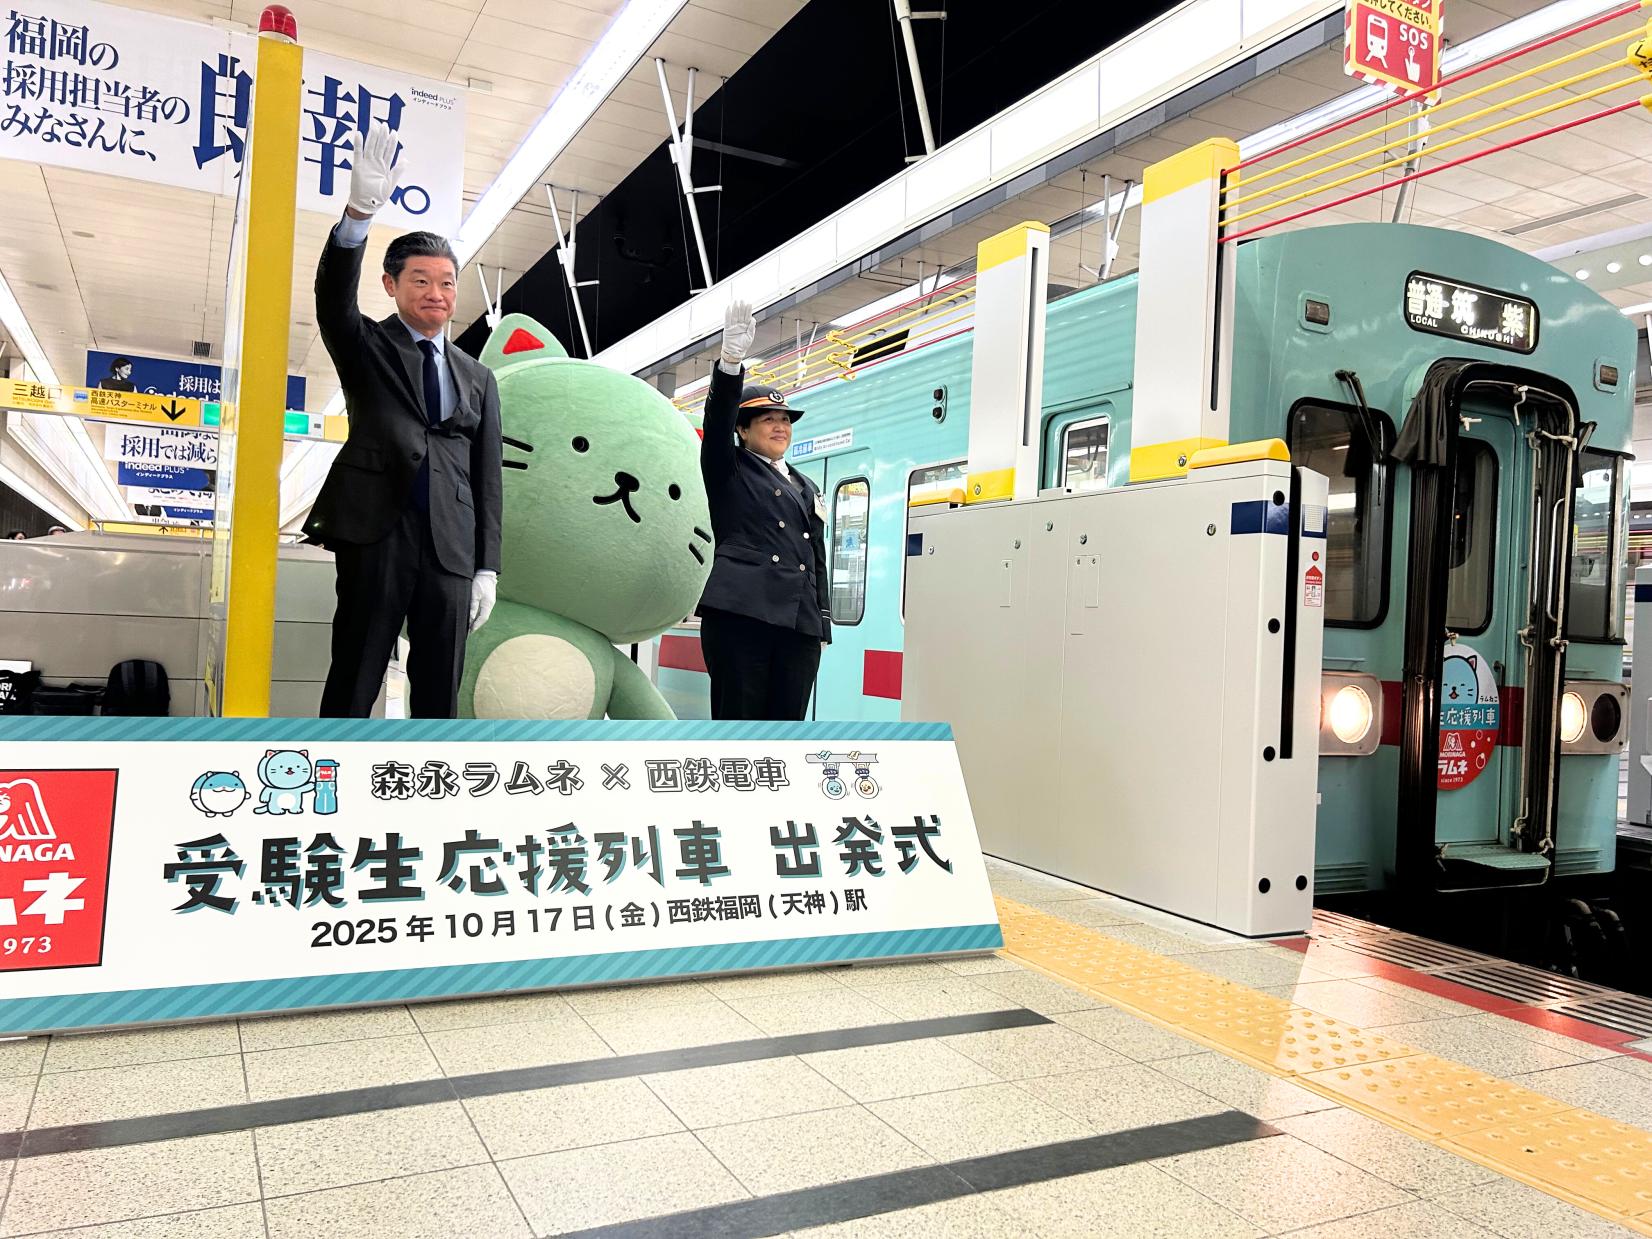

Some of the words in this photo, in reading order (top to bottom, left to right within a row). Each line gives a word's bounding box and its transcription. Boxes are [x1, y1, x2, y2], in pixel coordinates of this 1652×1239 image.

[5, 10, 119, 70] 福岡の
[1400, 24, 1428, 50] SOS
[3, 60, 191, 125] 採用担当者の
[411, 88, 438, 101] indeed
[0, 103, 157, 162] みなさんに、
[1407, 279, 1443, 319] 普通
[1410, 314, 1438, 328] LOCAL
[12, 383, 62, 399] 三越口
[178, 374, 221, 394] 採用は
[91, 390, 122, 399] 西鉄天神
[91, 397, 157, 411] 高速バスターミナル
[121, 434, 217, 464] 採用では減ら
[136, 472, 174, 480] インディードプラス
[164, 465, 185, 474] PLUS
[1438, 760, 1468, 775] ラムネ
[371, 760, 583, 801] 森永ラムネ
[646, 757, 790, 793] 西鉄電車
[163, 820, 731, 915] 受験生応援列車
[770, 814, 953, 878] 出発式
